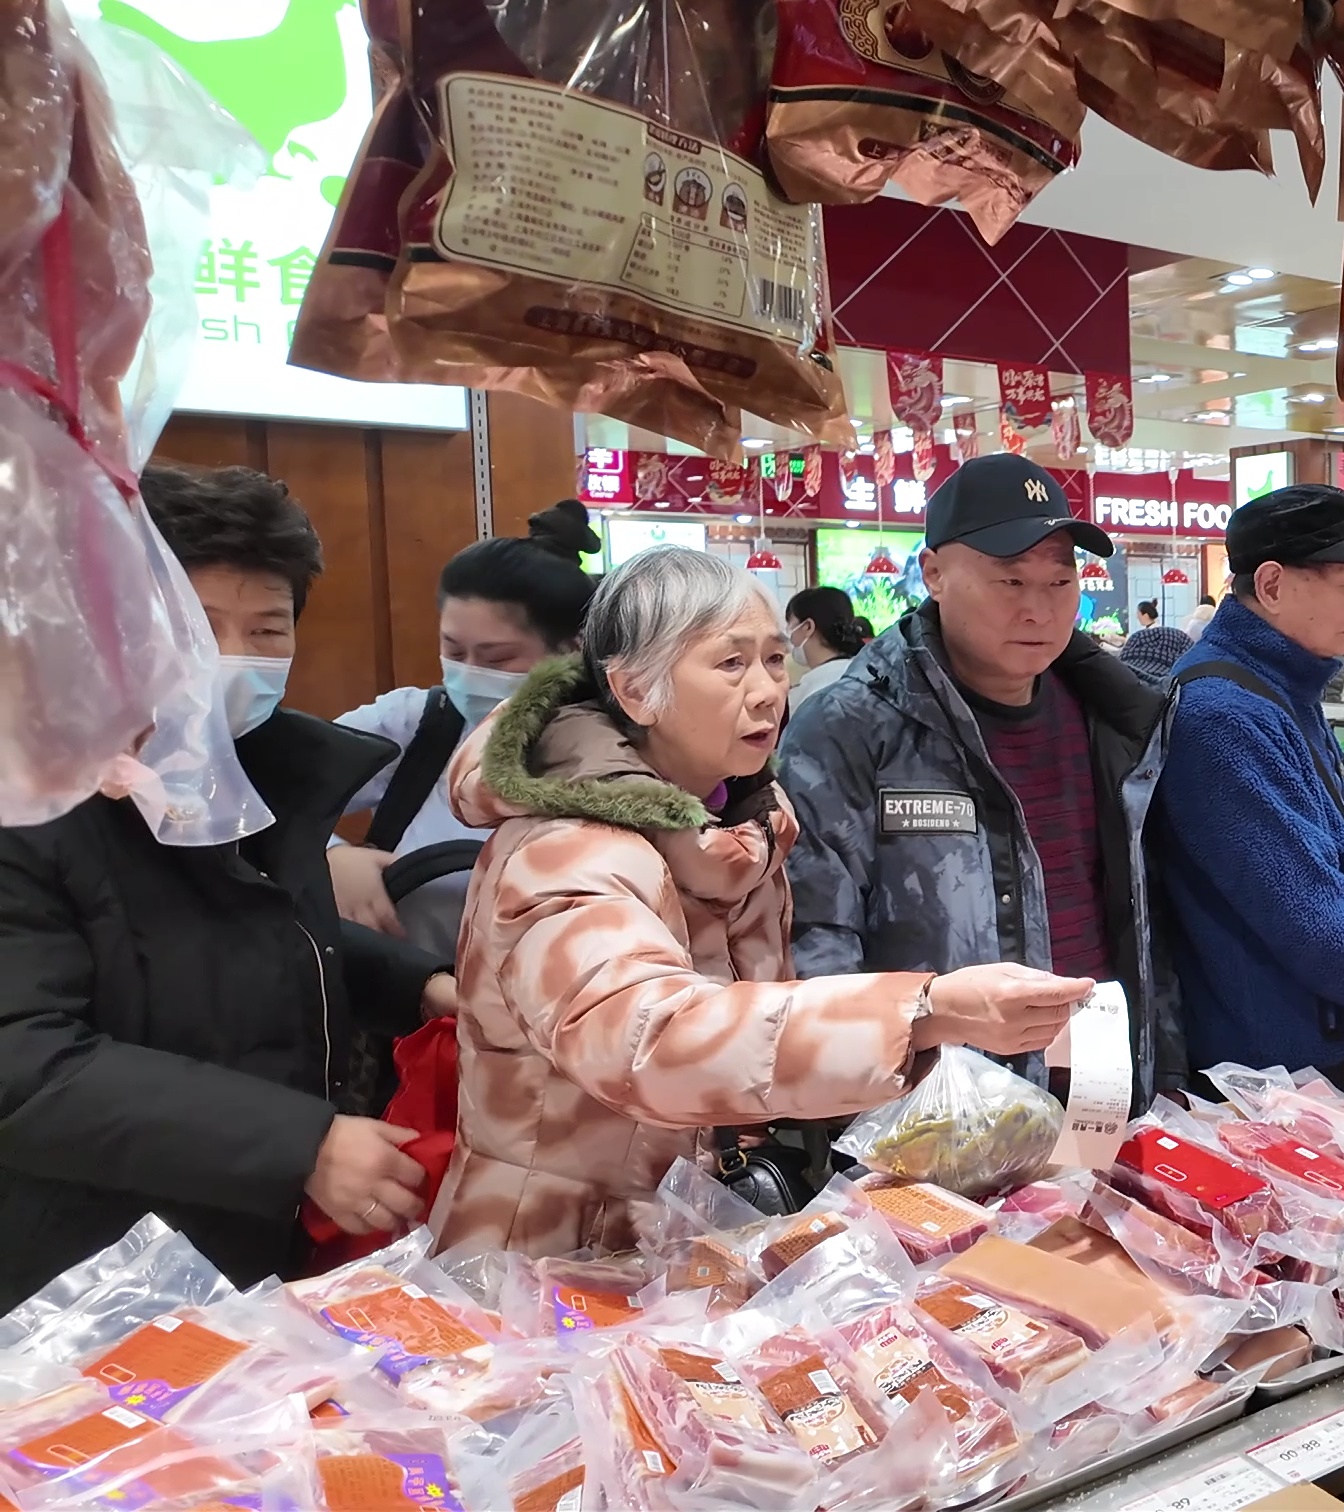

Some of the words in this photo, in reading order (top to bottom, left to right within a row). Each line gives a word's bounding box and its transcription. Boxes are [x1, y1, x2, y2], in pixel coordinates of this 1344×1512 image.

[202, 315, 261, 344] sh
[1094, 496, 1178, 527] FRESH
[1183, 502, 1232, 531] FOO
[885, 799, 974, 817] EXTREME-70
